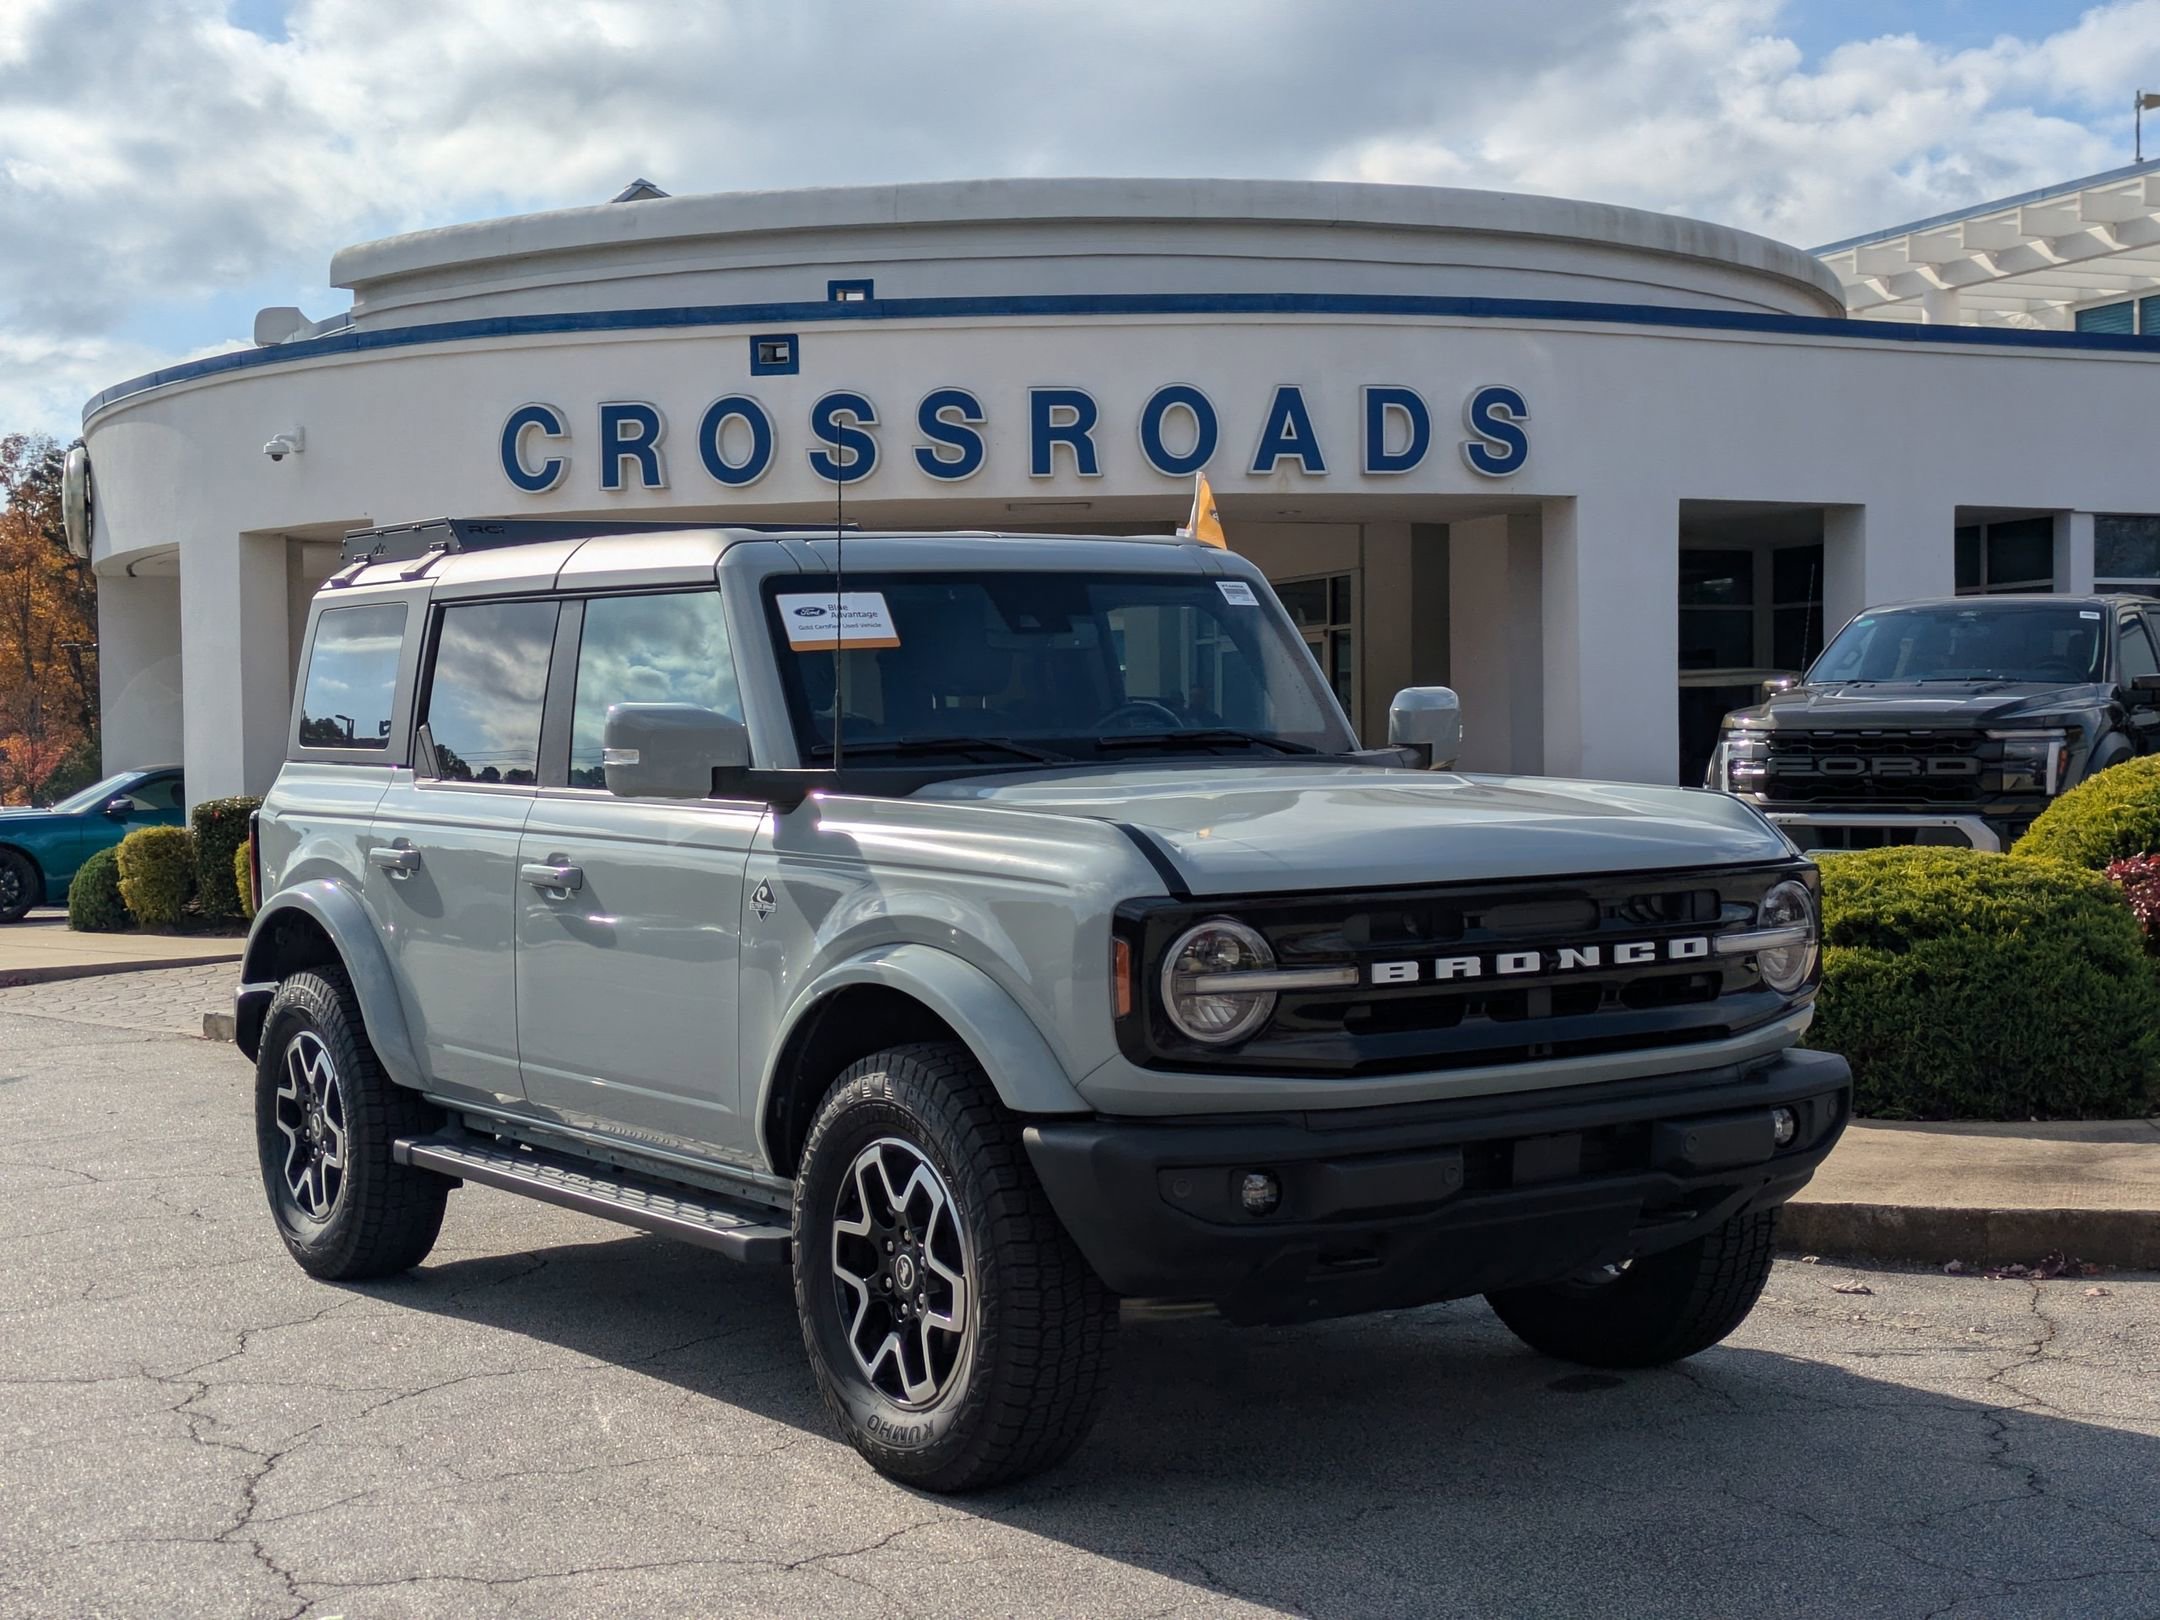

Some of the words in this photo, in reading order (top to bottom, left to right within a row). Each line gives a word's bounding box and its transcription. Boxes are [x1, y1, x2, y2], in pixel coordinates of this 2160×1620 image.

[499, 381, 1532, 494] CROSSROADS
[1766, 756, 1983, 777] FORD
[1371, 937, 1708, 984] BRONCO
[866, 1414, 934, 1444] KUMHO
